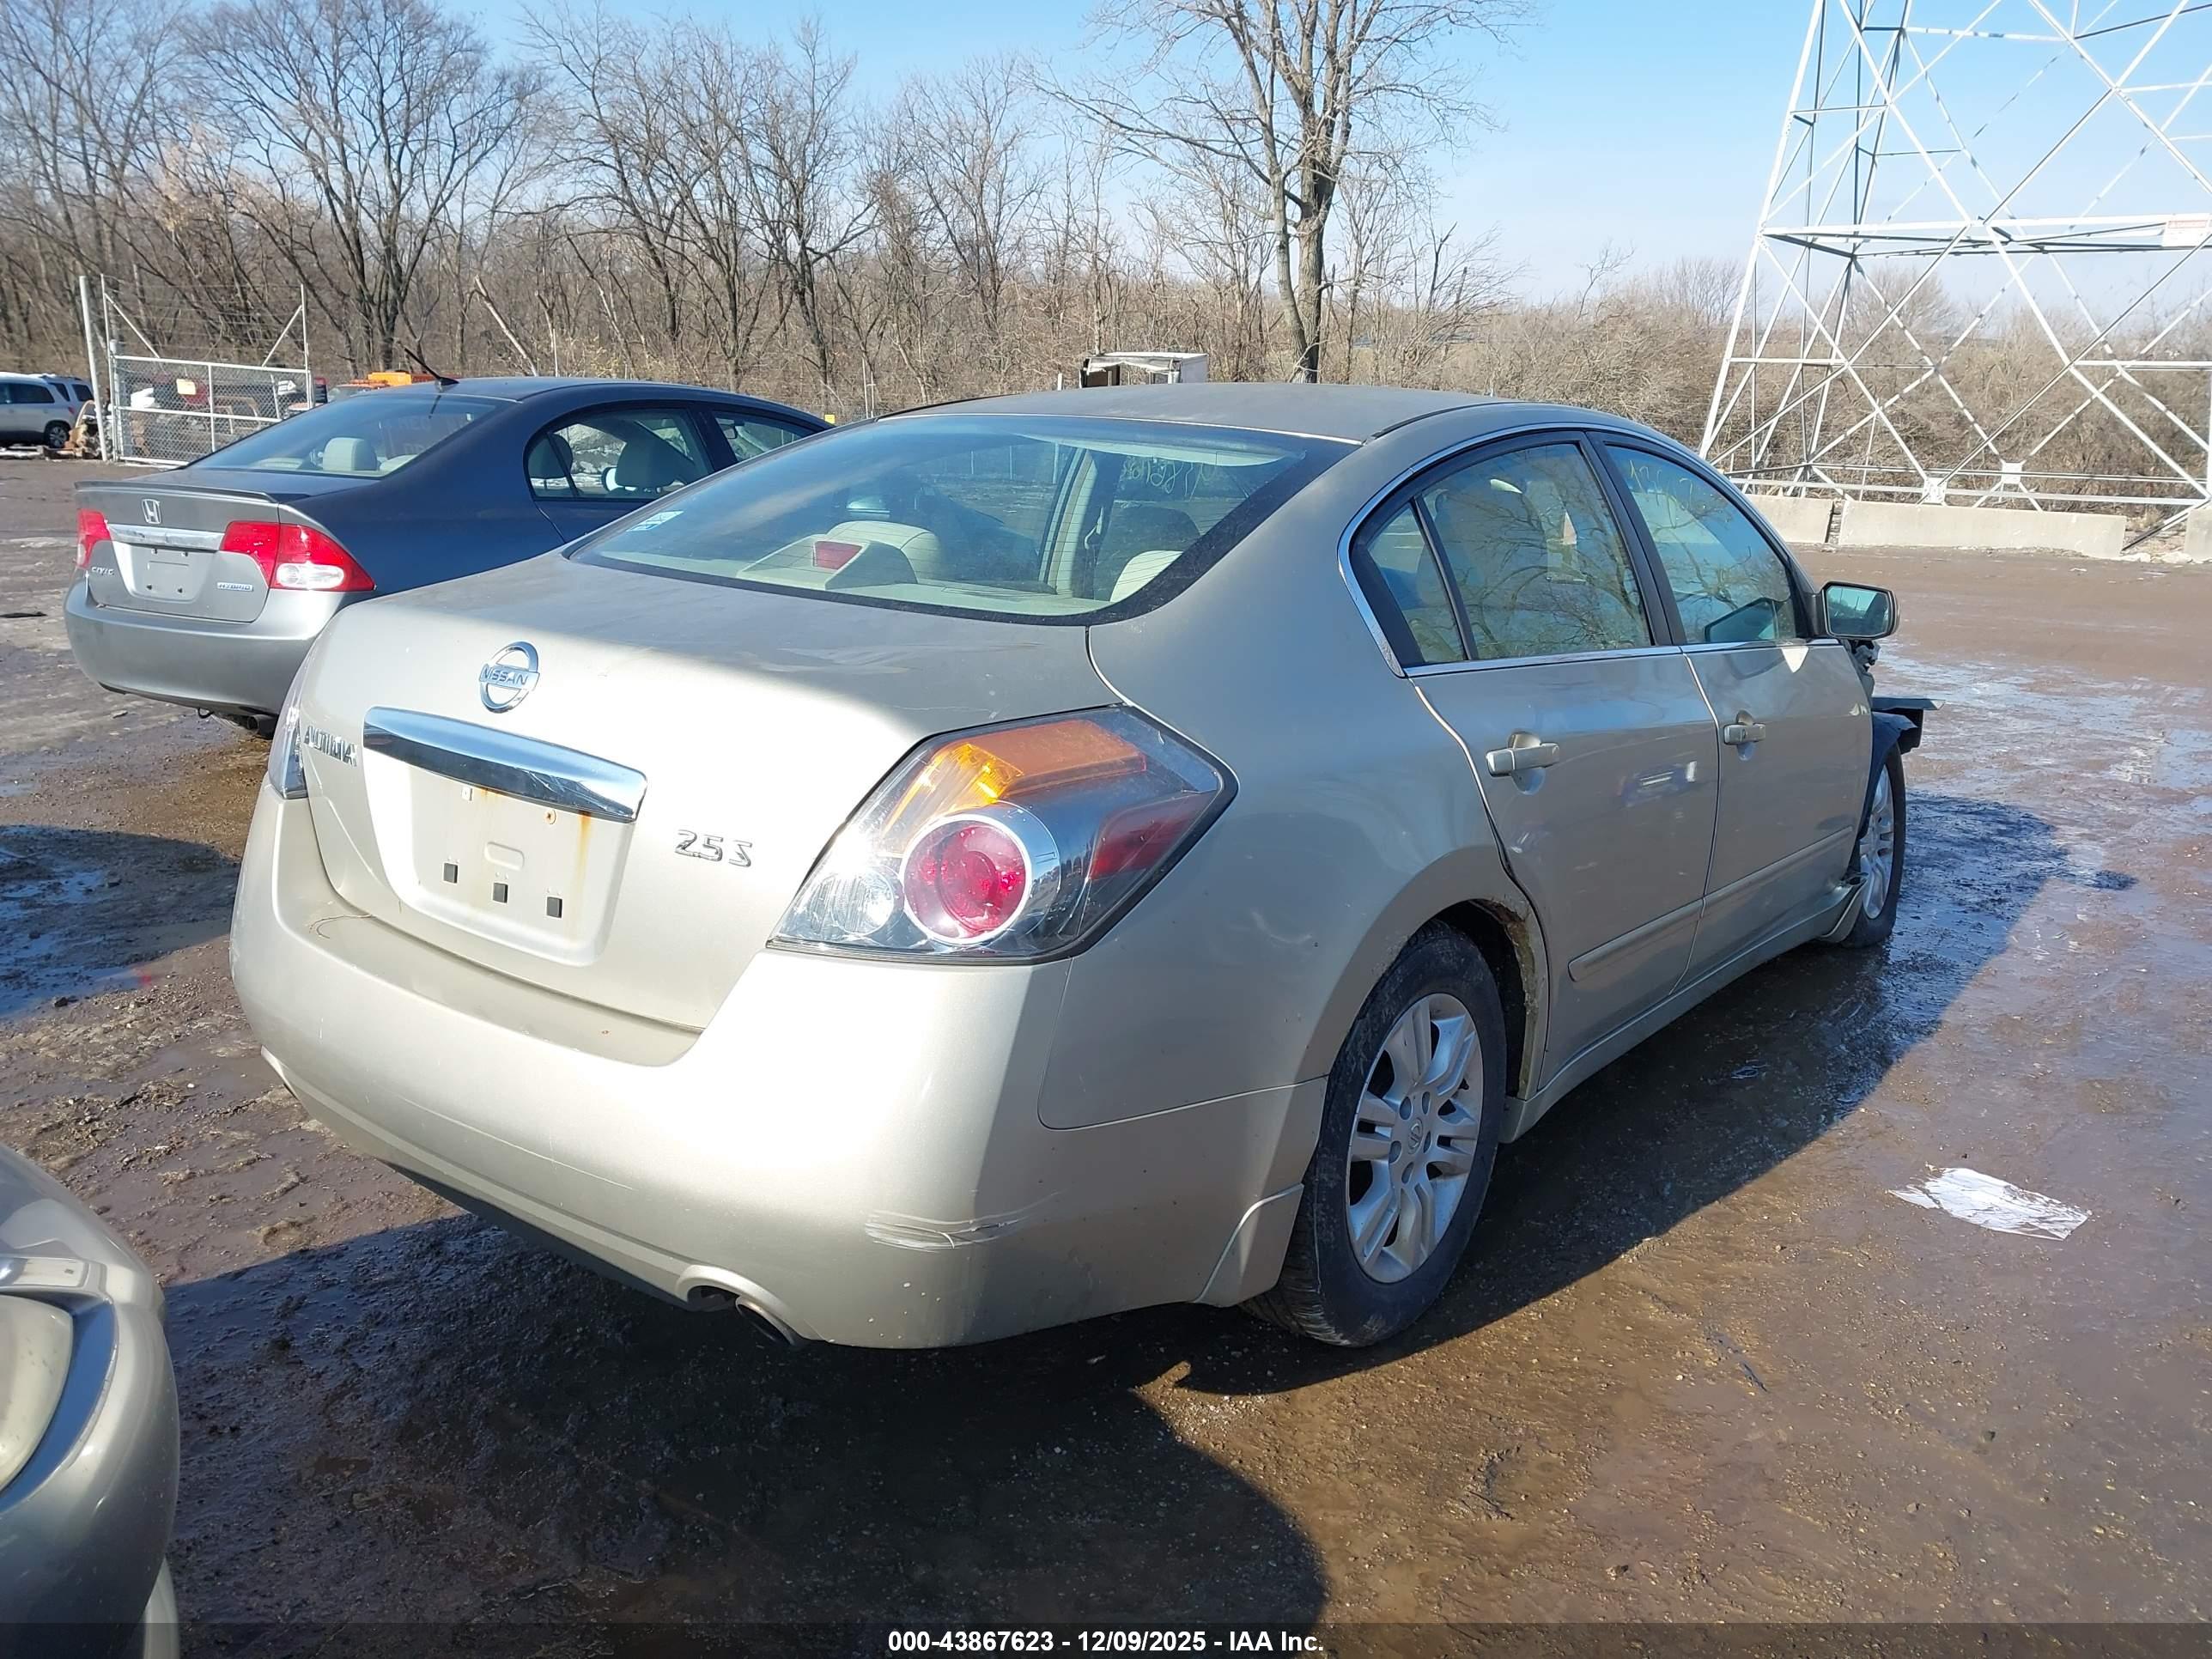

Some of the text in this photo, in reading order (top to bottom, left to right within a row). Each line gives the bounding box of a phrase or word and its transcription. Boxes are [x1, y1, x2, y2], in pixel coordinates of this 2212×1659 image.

[91, 566, 114, 576] CIVIC
[479, 664, 529, 685] NISSAN
[728, 839, 753, 867] S
